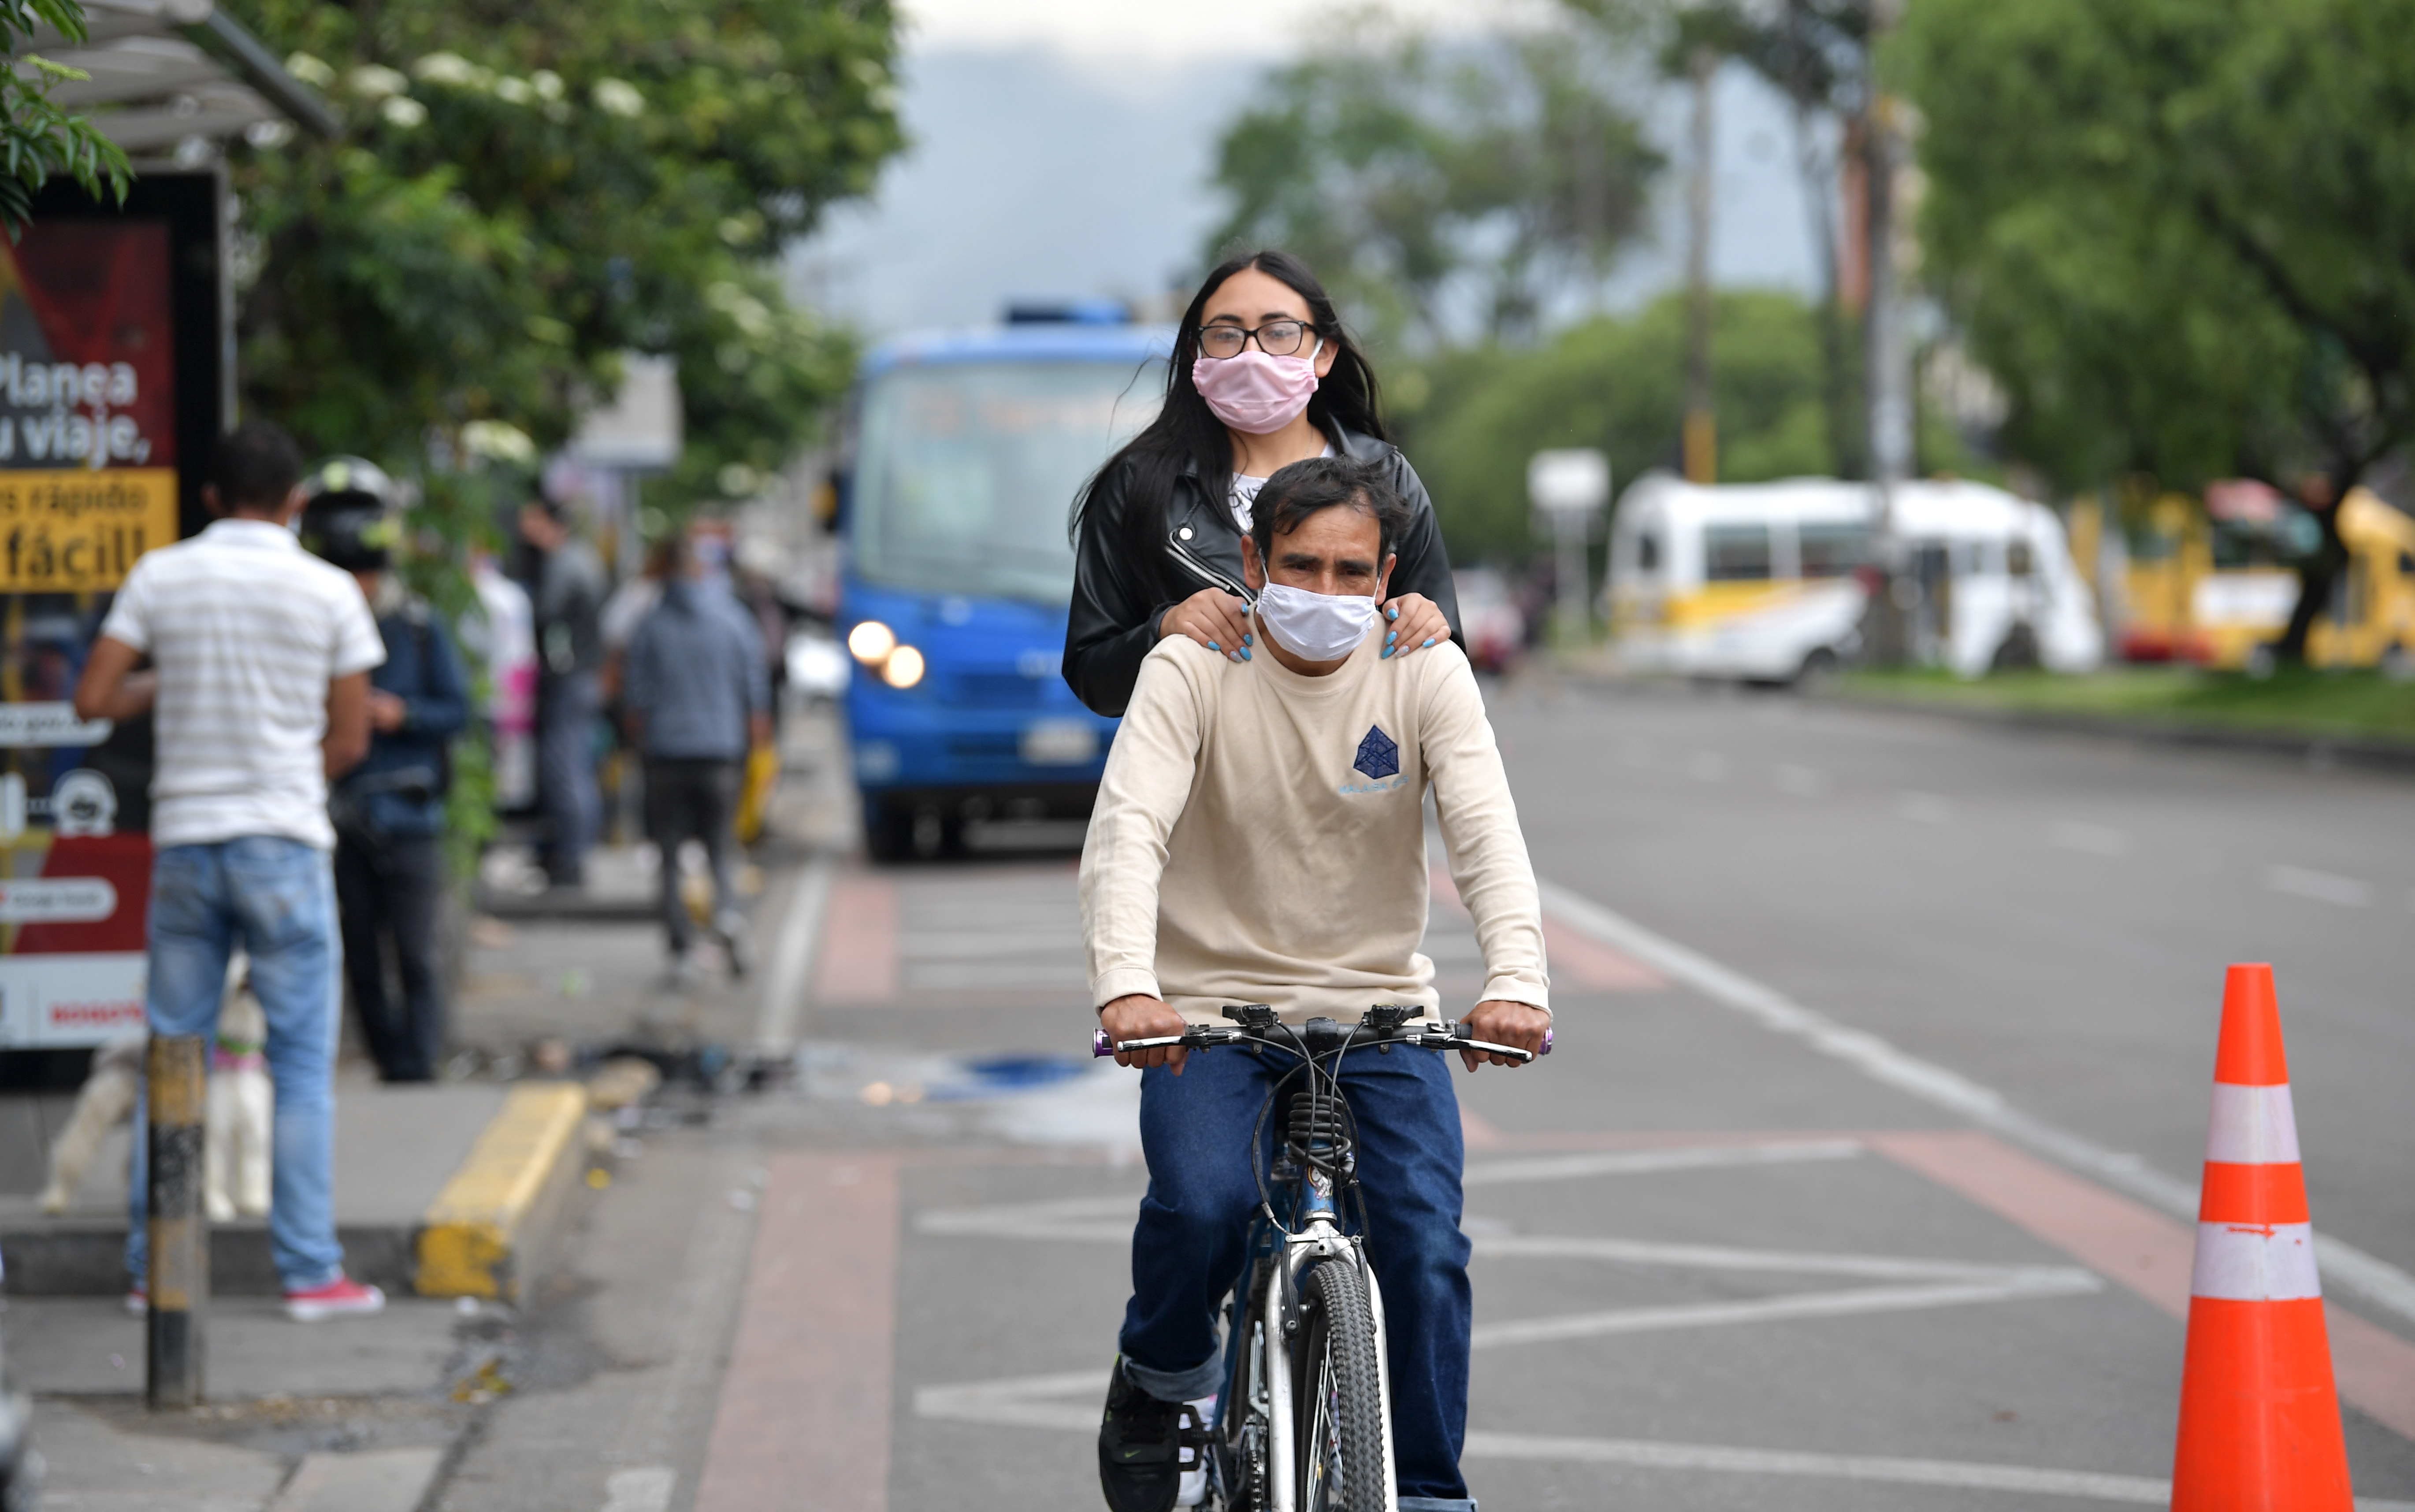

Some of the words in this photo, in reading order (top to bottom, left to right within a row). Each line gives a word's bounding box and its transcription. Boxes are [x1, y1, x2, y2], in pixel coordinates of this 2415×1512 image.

[0, 352, 137, 406] lanea
[21, 404, 151, 471] viaje,
[29, 473, 149, 519] rápido
